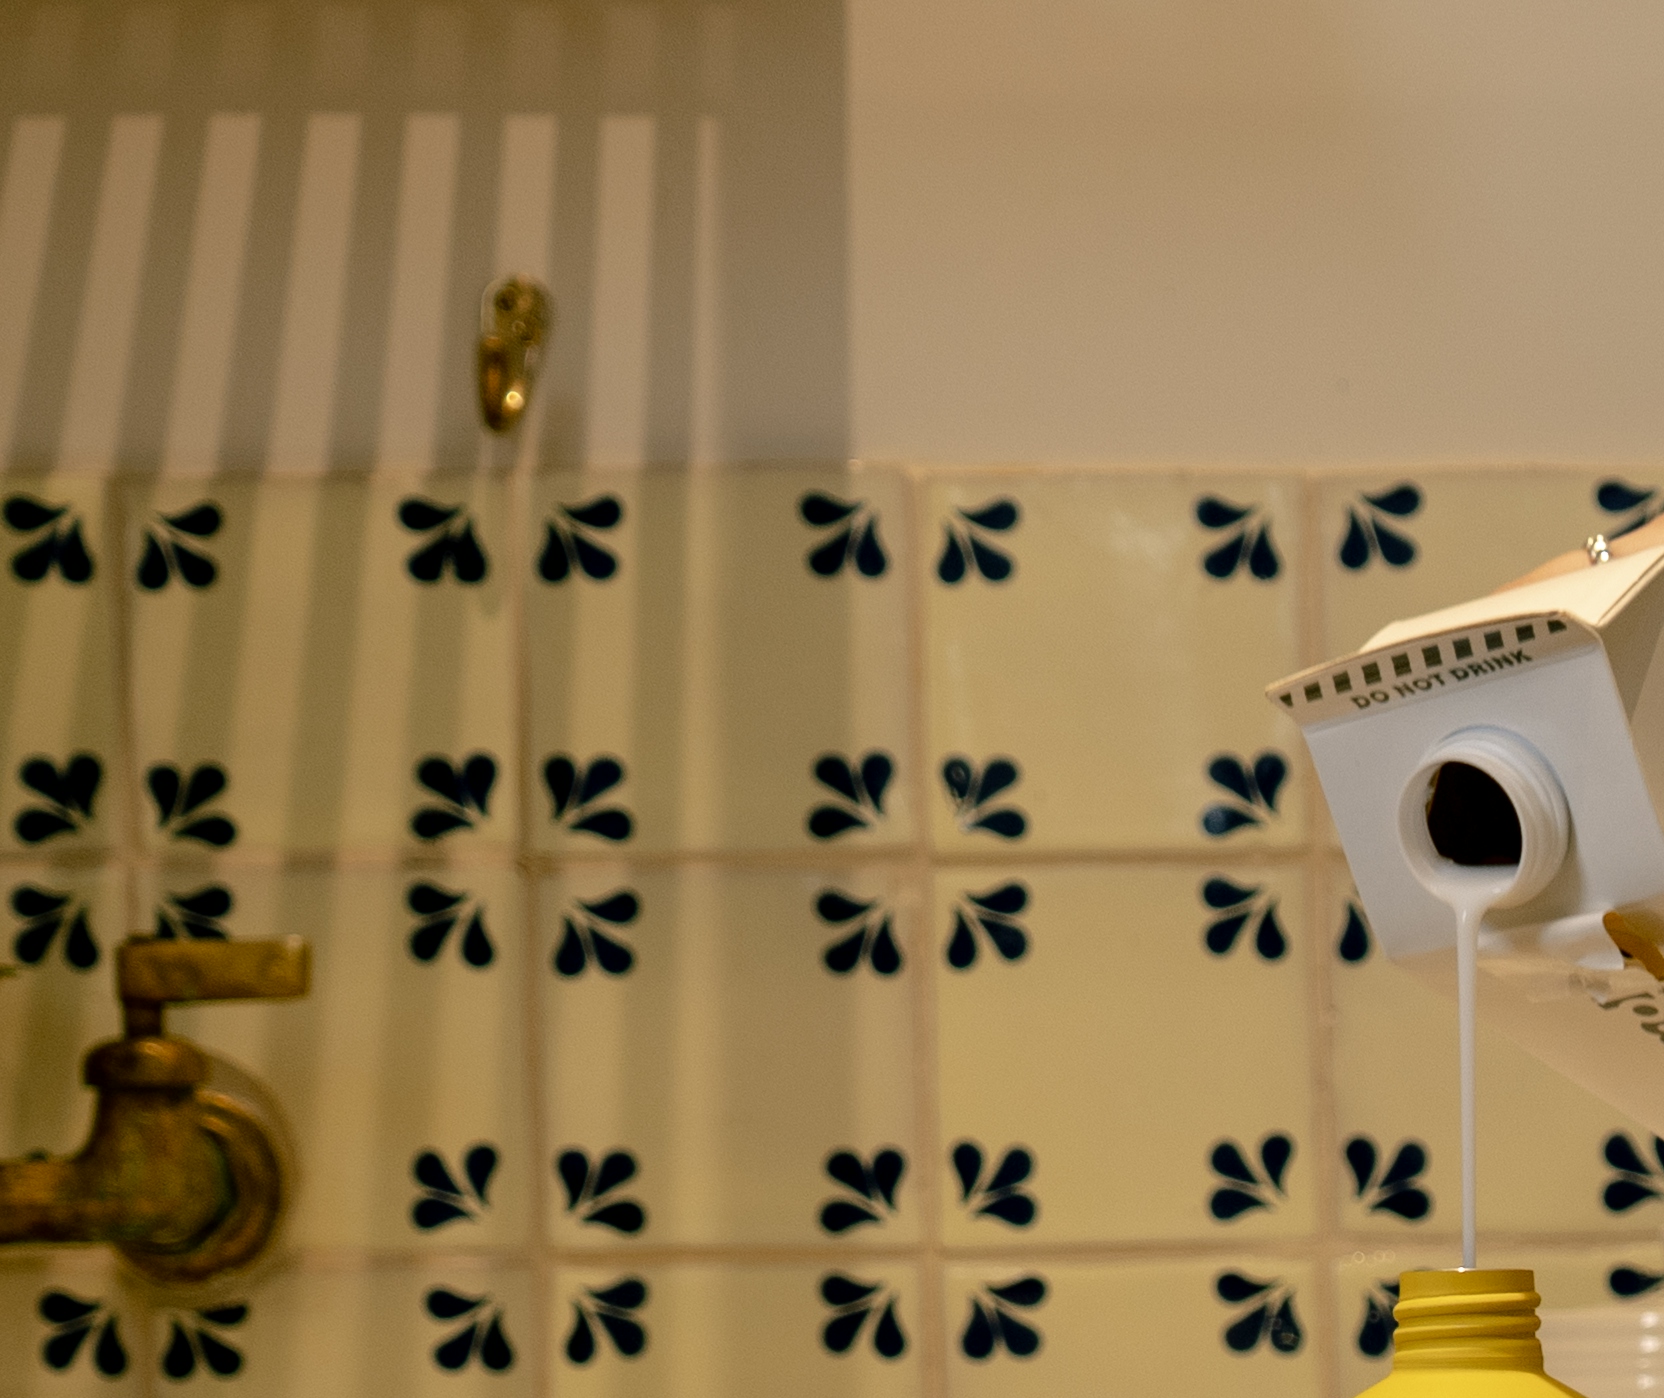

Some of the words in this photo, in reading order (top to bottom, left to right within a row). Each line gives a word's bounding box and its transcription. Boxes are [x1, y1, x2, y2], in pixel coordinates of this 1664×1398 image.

[1351, 689, 1390, 710] DO
[1393, 672, 1446, 699] NOT
[1449, 647, 1534, 683] DRINK
